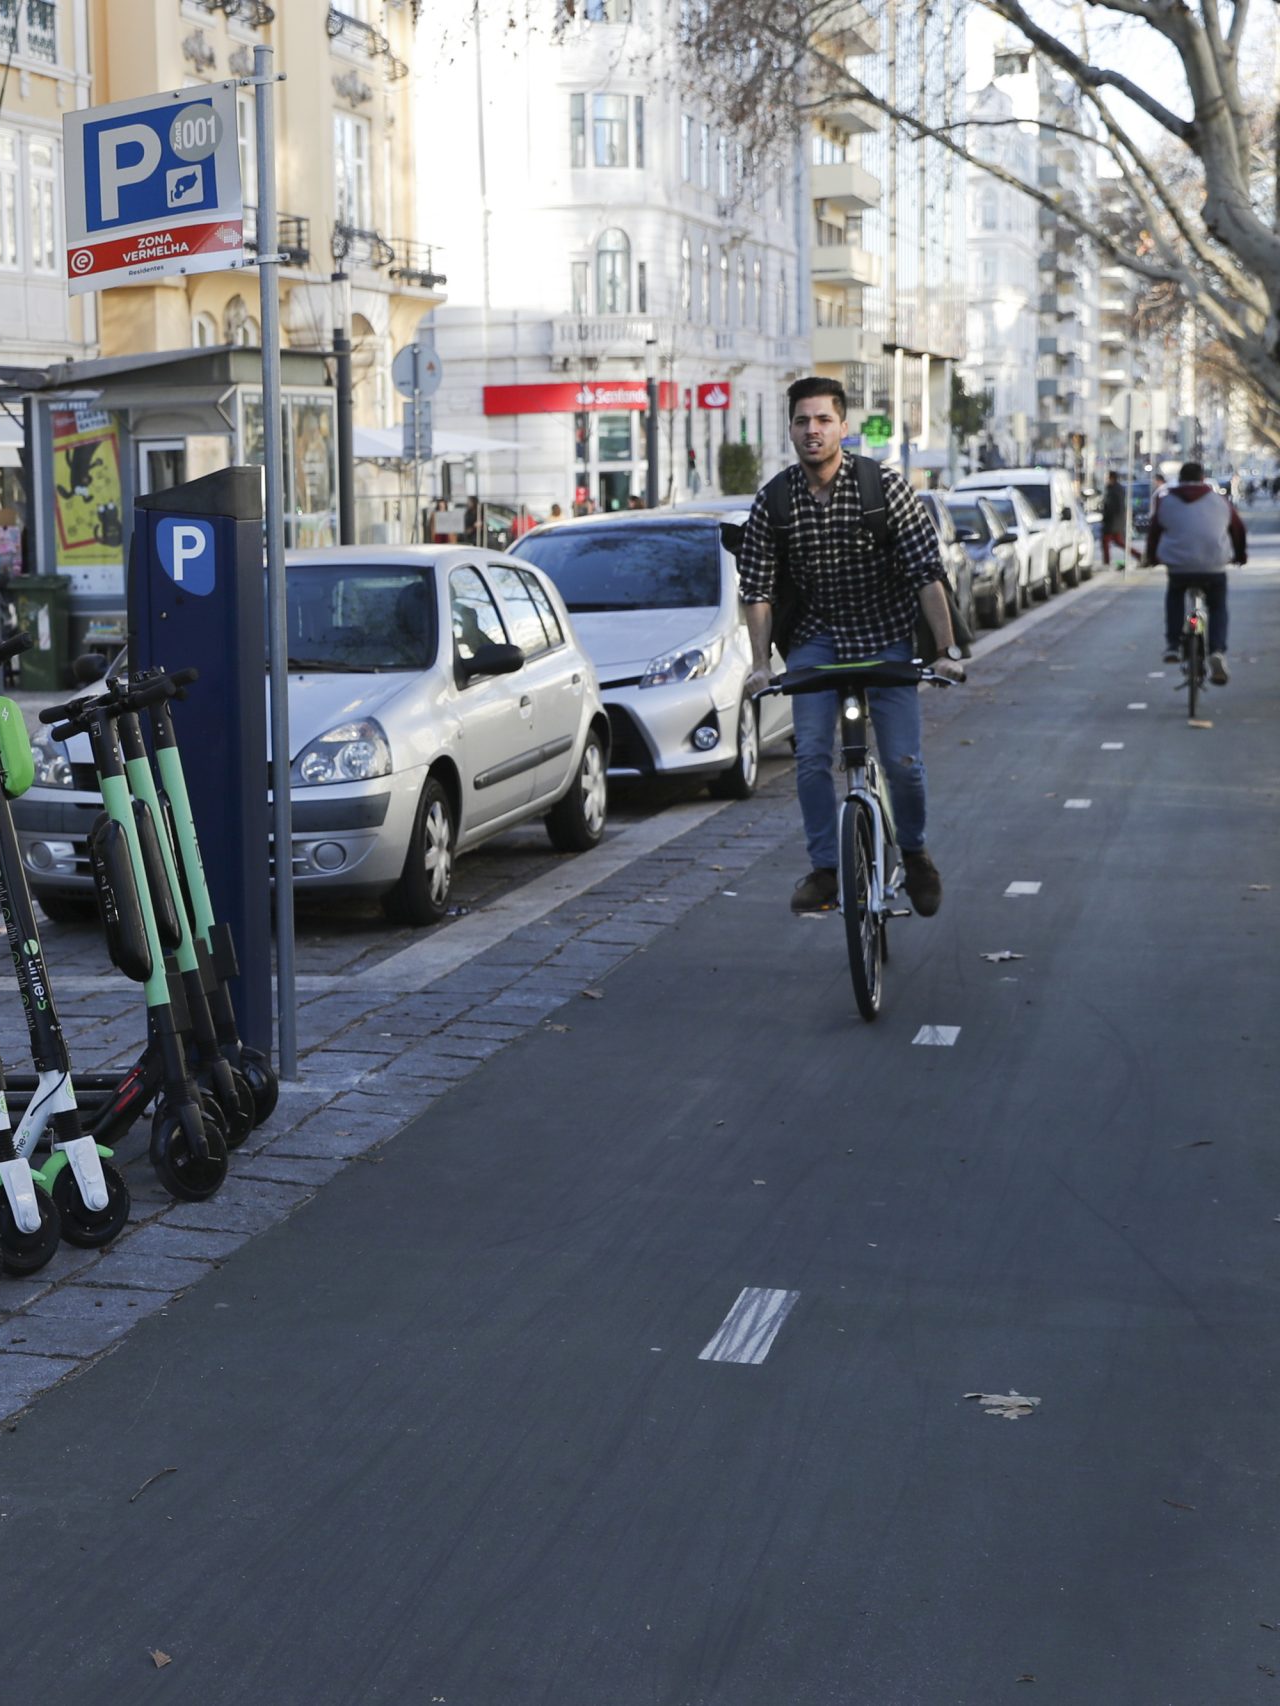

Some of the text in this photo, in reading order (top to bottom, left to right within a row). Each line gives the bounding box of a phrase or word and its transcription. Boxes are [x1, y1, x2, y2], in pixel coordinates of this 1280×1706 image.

[174, 116, 216, 150] Zona 001
[98, 123, 162, 222] P
[122, 242, 190, 263] VERMELHA
[137, 233, 173, 249] ZONA
[128, 264, 165, 277] Residentes
[173, 525, 207, 581] P
